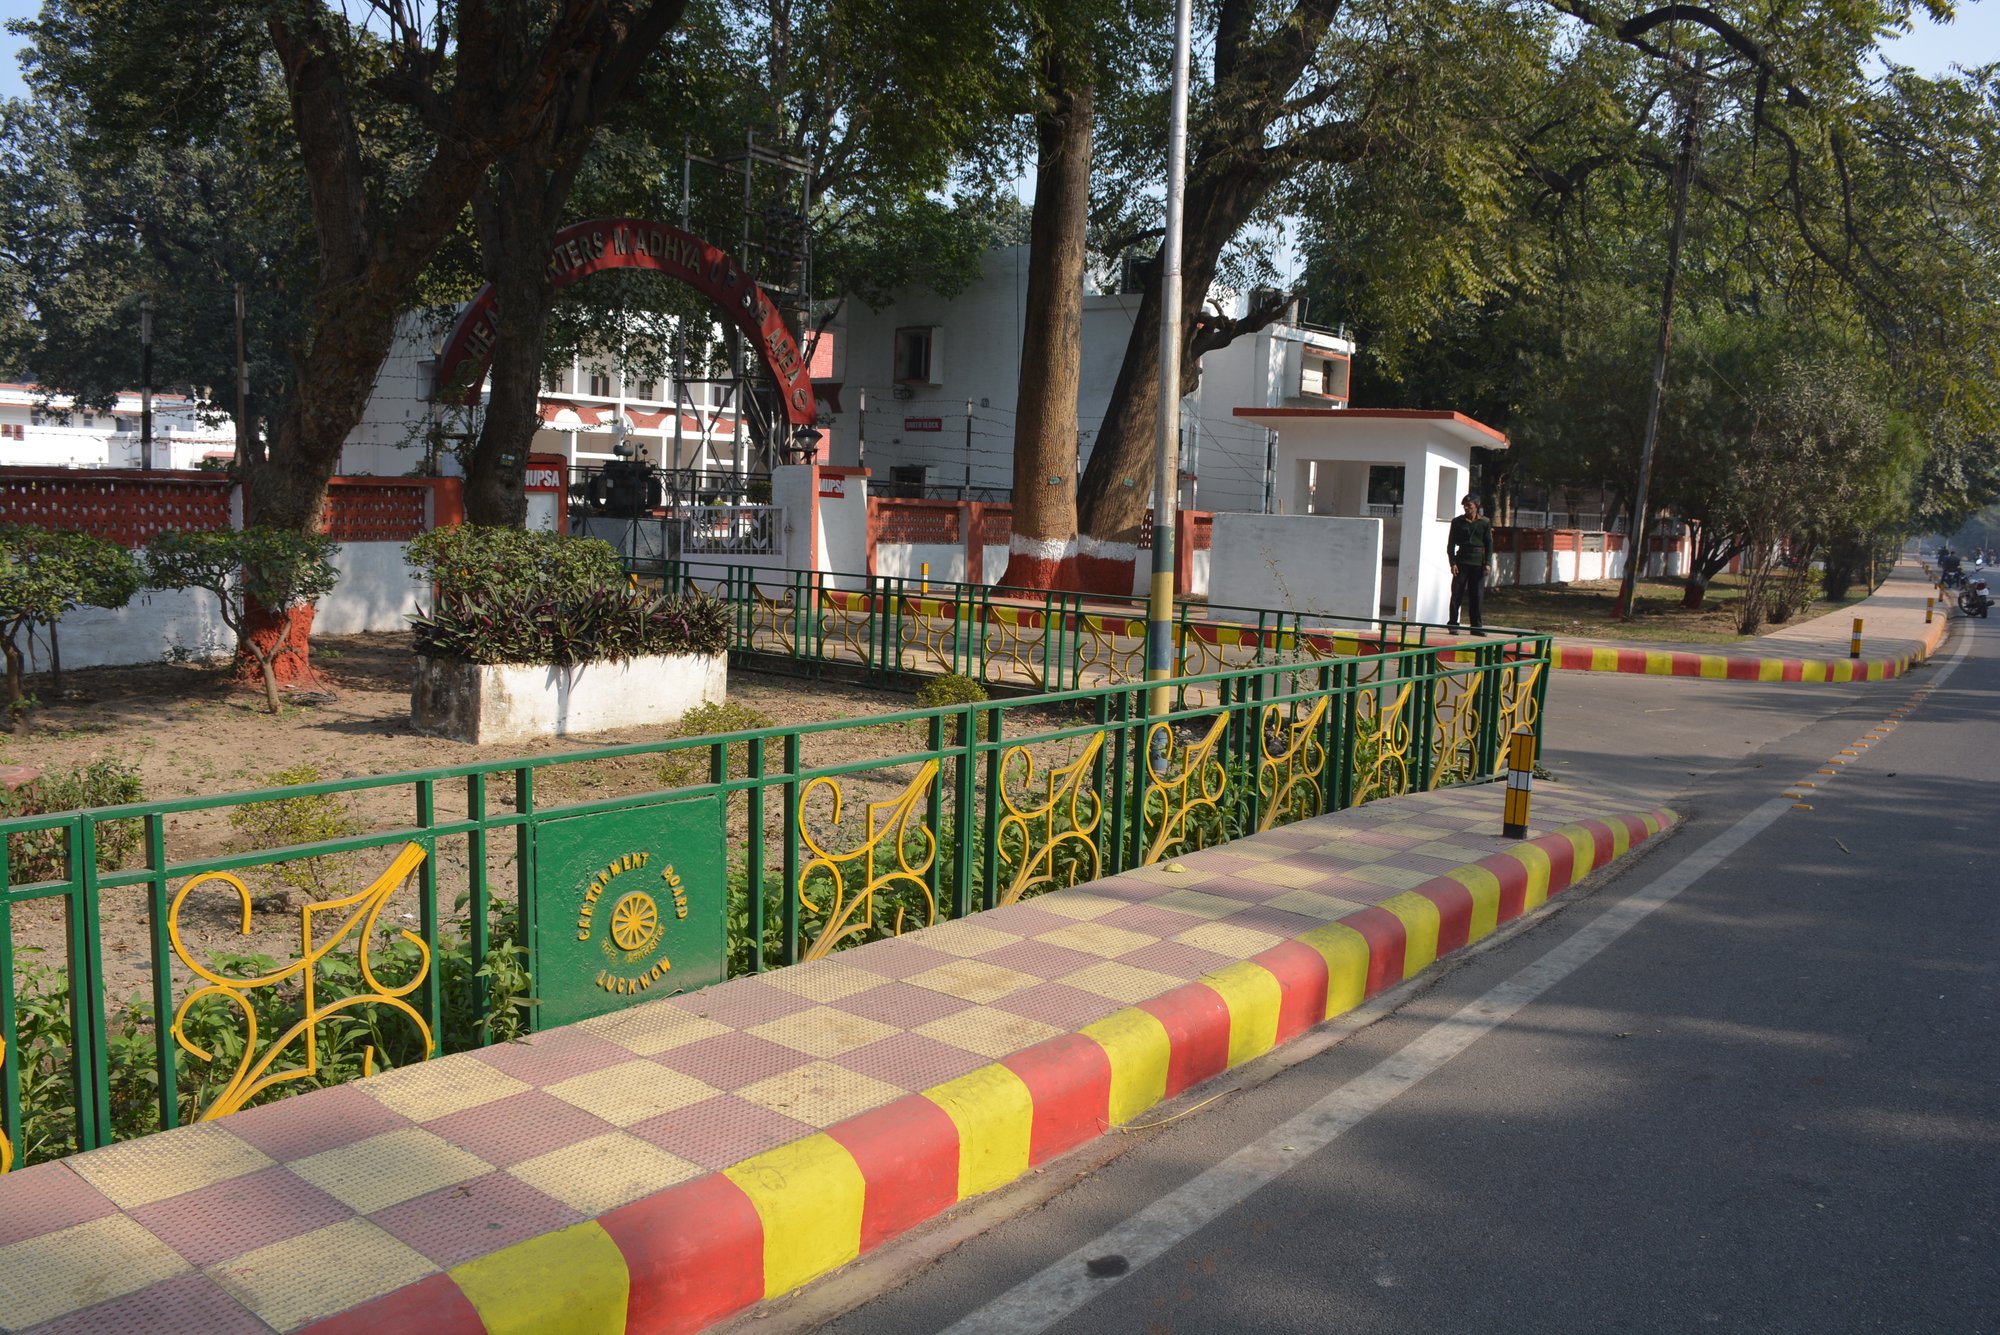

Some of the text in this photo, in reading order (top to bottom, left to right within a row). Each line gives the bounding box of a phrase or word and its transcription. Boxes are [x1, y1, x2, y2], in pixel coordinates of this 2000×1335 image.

[613, 228, 701, 274] MADHYA
[741, 287, 769, 327] SUB
[766, 328, 801, 387] AREA
[819, 478, 845, 493] MUPSA
[578, 852, 689, 941] CANTONMENT BOARD
[597, 956, 672, 995] LUCKNOW
